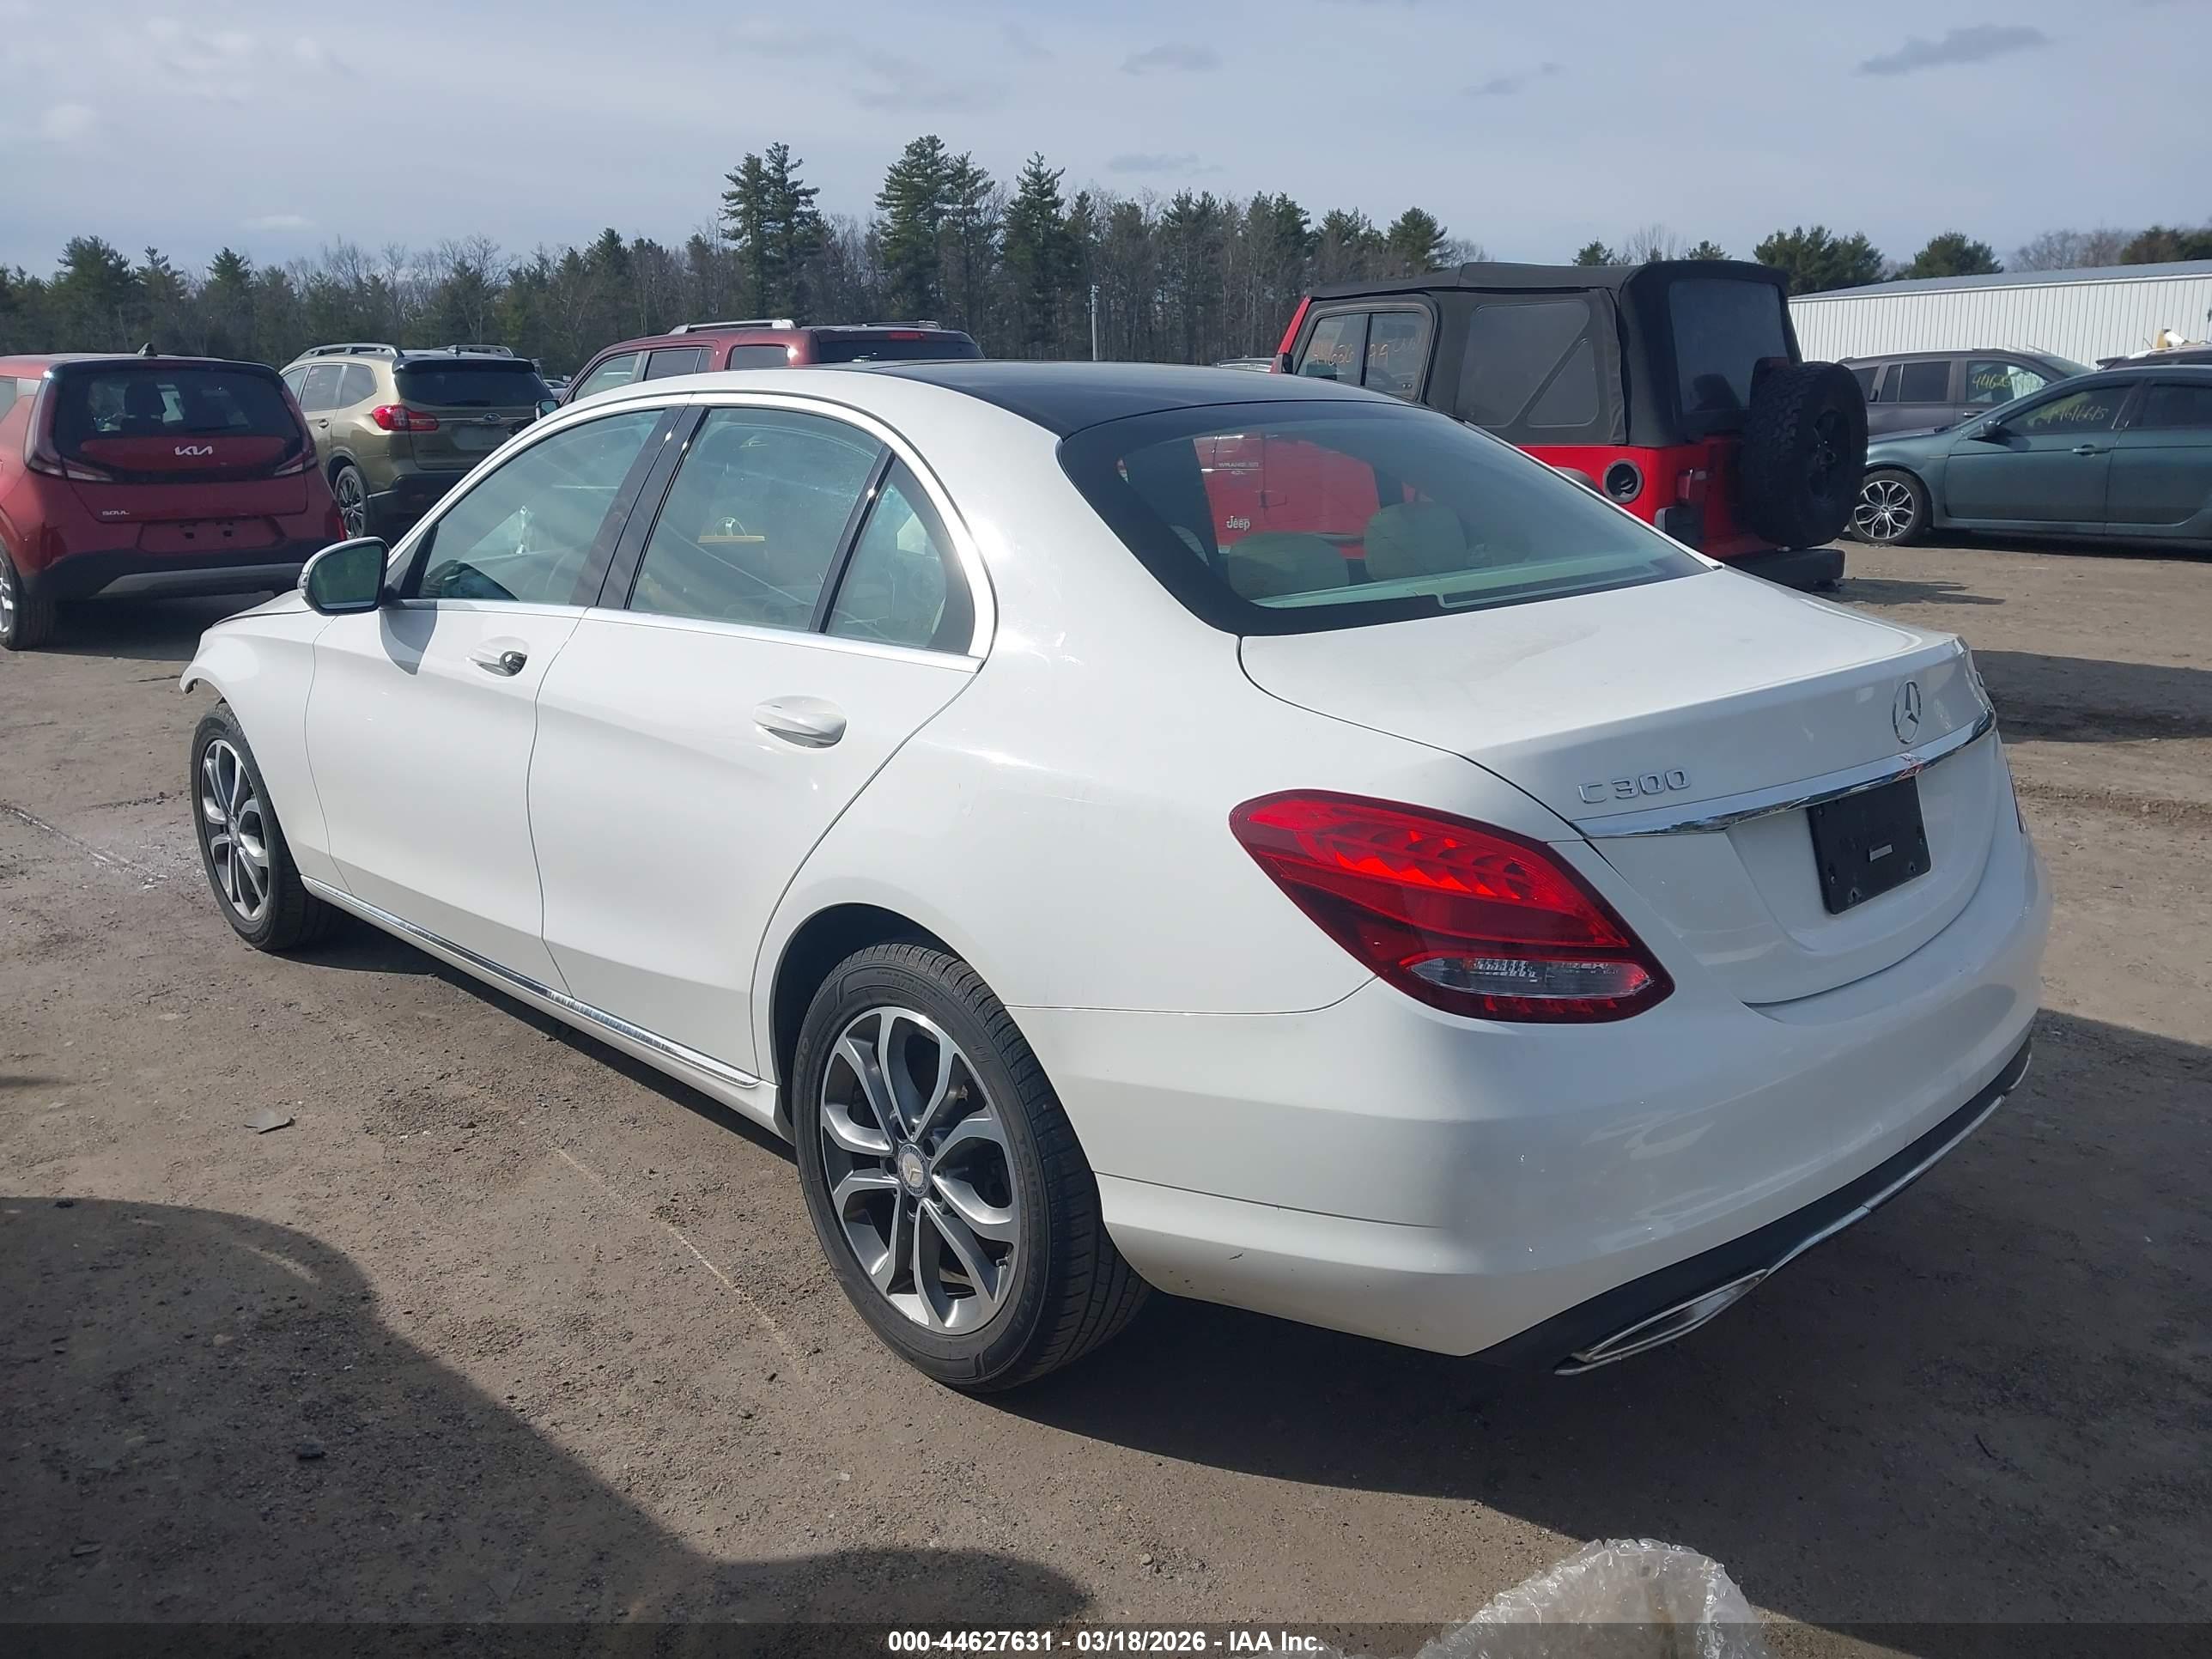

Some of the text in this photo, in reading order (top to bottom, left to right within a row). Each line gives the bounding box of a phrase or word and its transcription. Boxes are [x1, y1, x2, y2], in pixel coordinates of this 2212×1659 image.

[174, 446, 213, 455] KIA
[1225, 515, 1250, 532] Jeep
[1577, 769, 1692, 805] C 300
